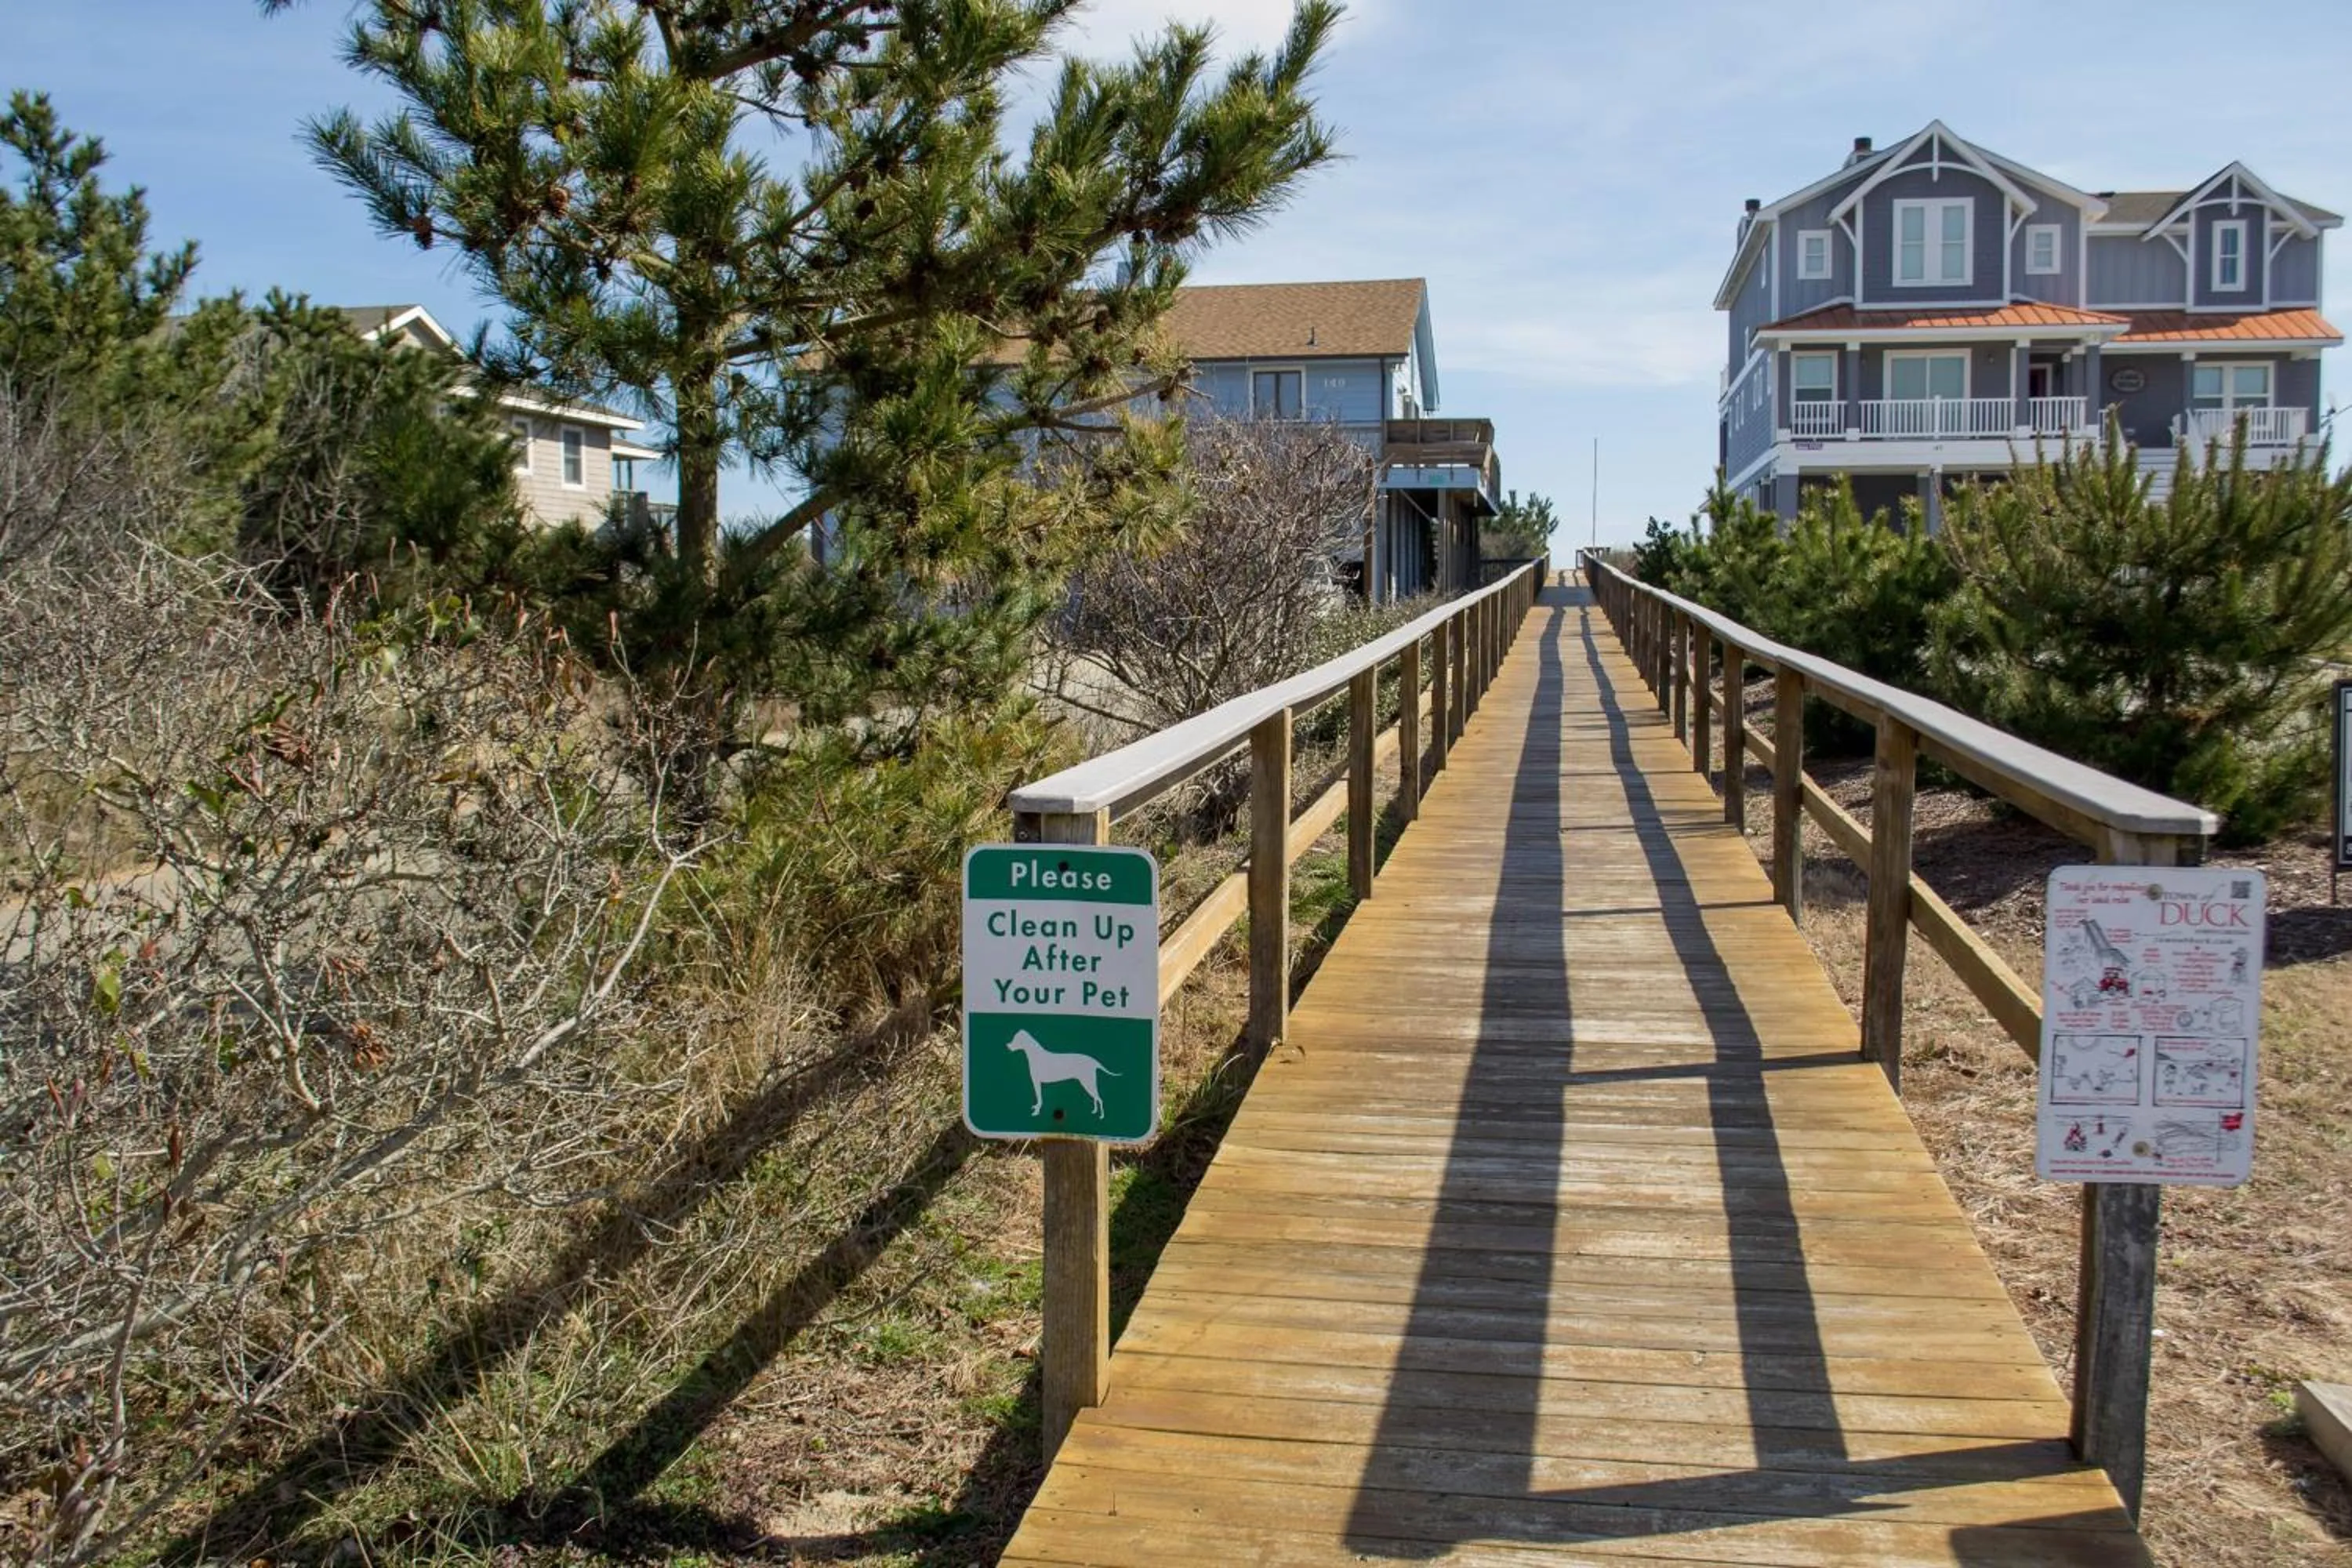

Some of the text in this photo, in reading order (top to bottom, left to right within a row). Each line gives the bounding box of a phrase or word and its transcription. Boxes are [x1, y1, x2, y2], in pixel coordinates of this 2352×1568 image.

[1011, 859, 1113, 891] Please
[987, 909, 1134, 948] Clean Up
[2160, 902, 2252, 927] DUCK
[1022, 943, 1102, 972] After
[993, 978, 1130, 1008] Your Pet
